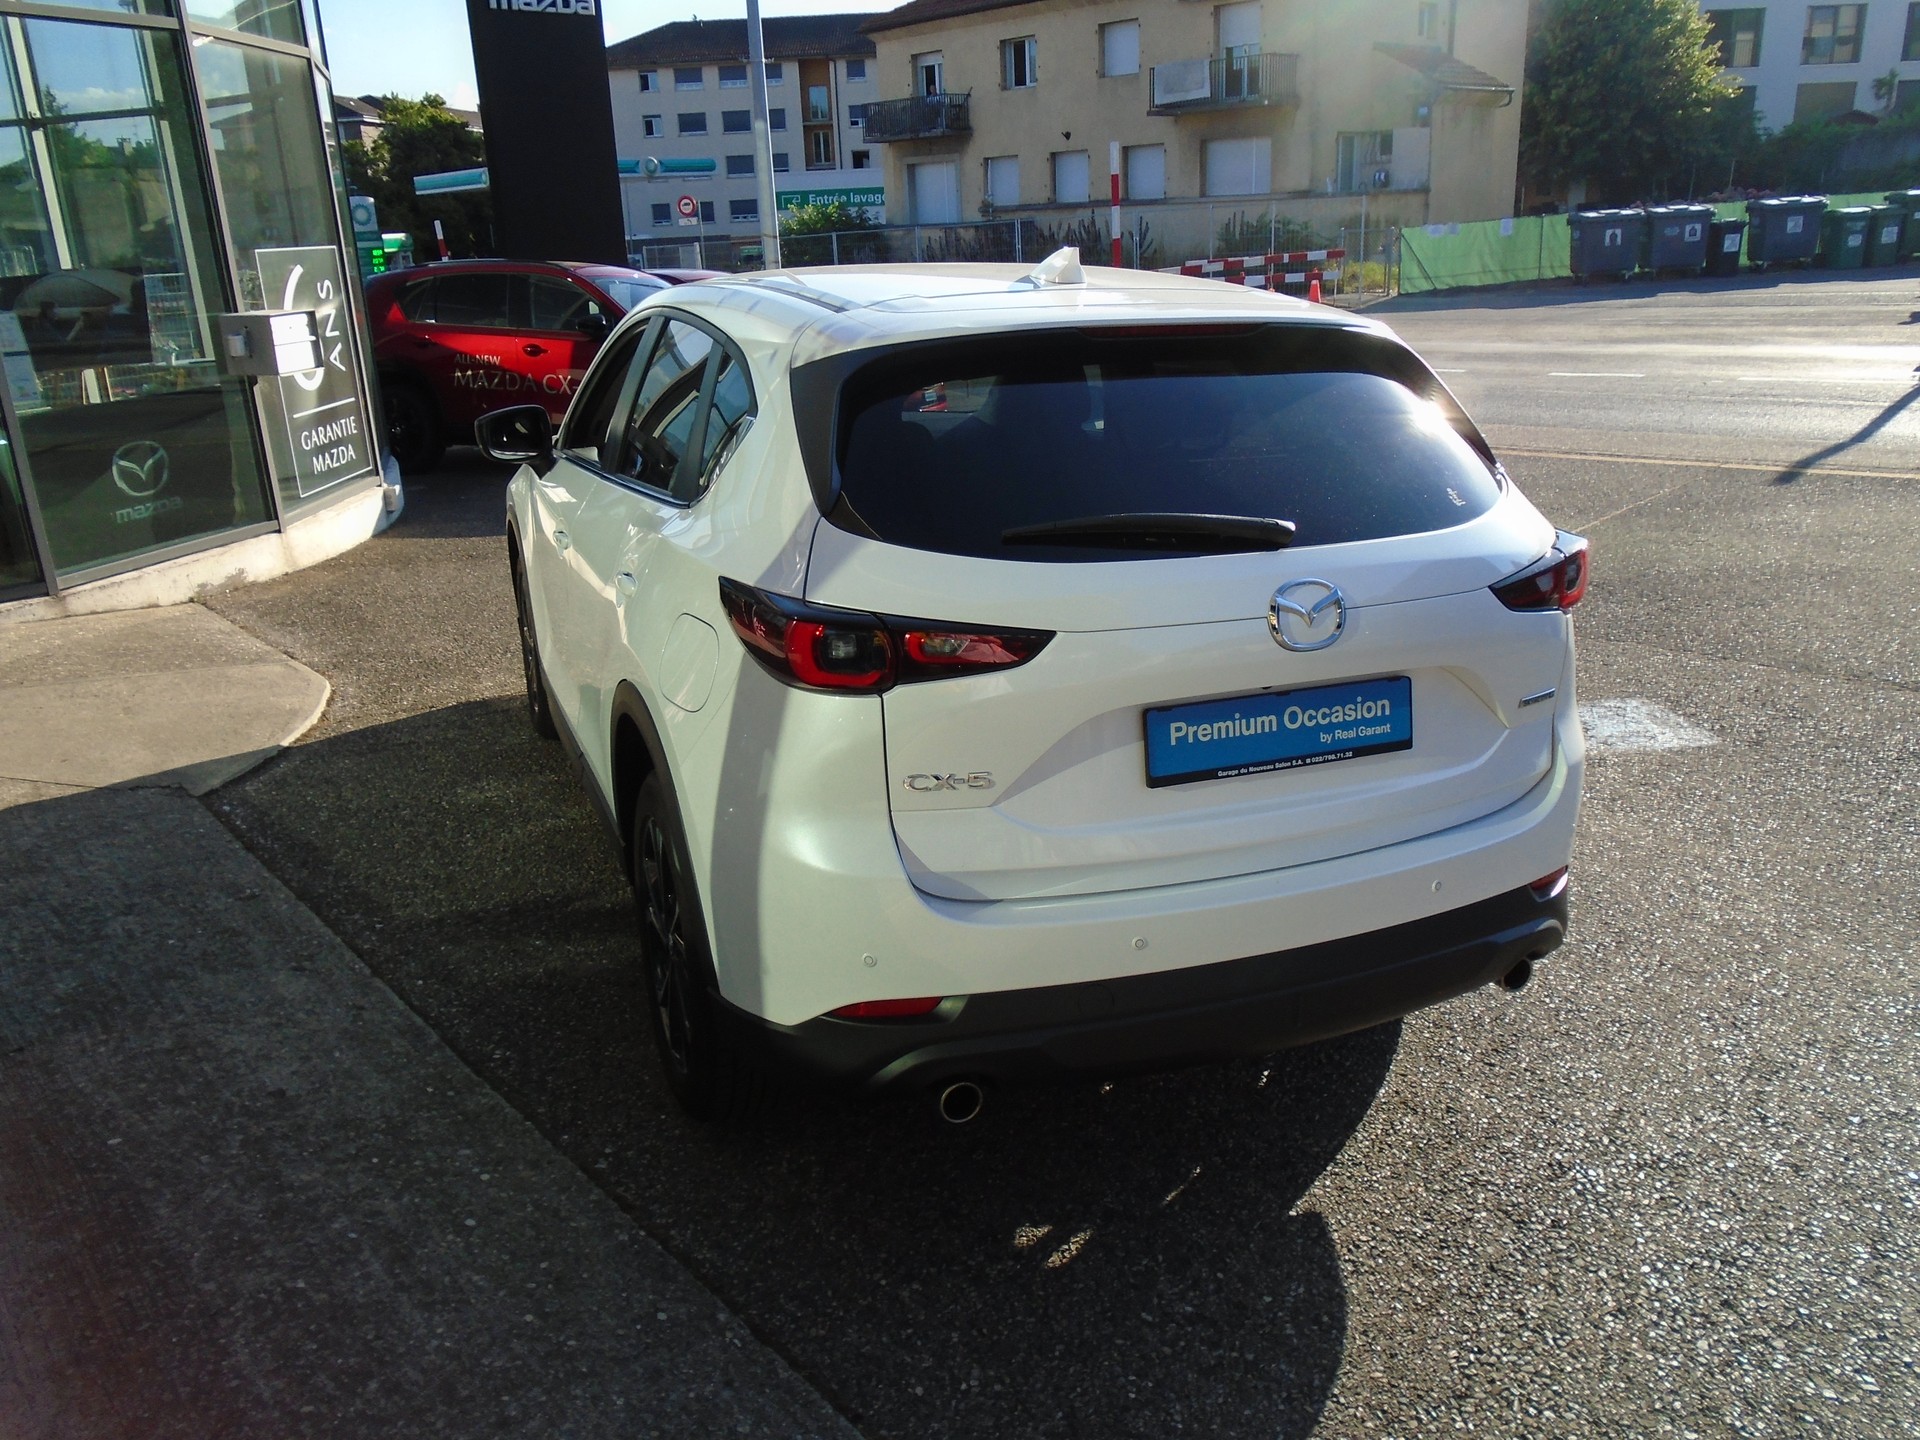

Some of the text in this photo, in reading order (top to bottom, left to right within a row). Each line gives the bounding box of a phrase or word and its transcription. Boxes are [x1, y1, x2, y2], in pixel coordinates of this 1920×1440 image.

[317, 279, 347, 372] ANS
[454, 353, 501, 366] ALL-NEW
[453, 368, 538, 392] MAZDA
[301, 416, 358, 450] GARANTIE
[313, 443, 356, 475] MAZDA
[116, 496, 184, 524] mazda
[1170, 696, 1391, 745] Premium Occasion
[1320, 723, 1391, 744] by Real Garant
[903, 771, 995, 792] CX-5
[1217, 769, 1239, 777] Garage
[1249, 764, 1274, 773] Nouveau
[1275, 761, 1291, 769] Salon
